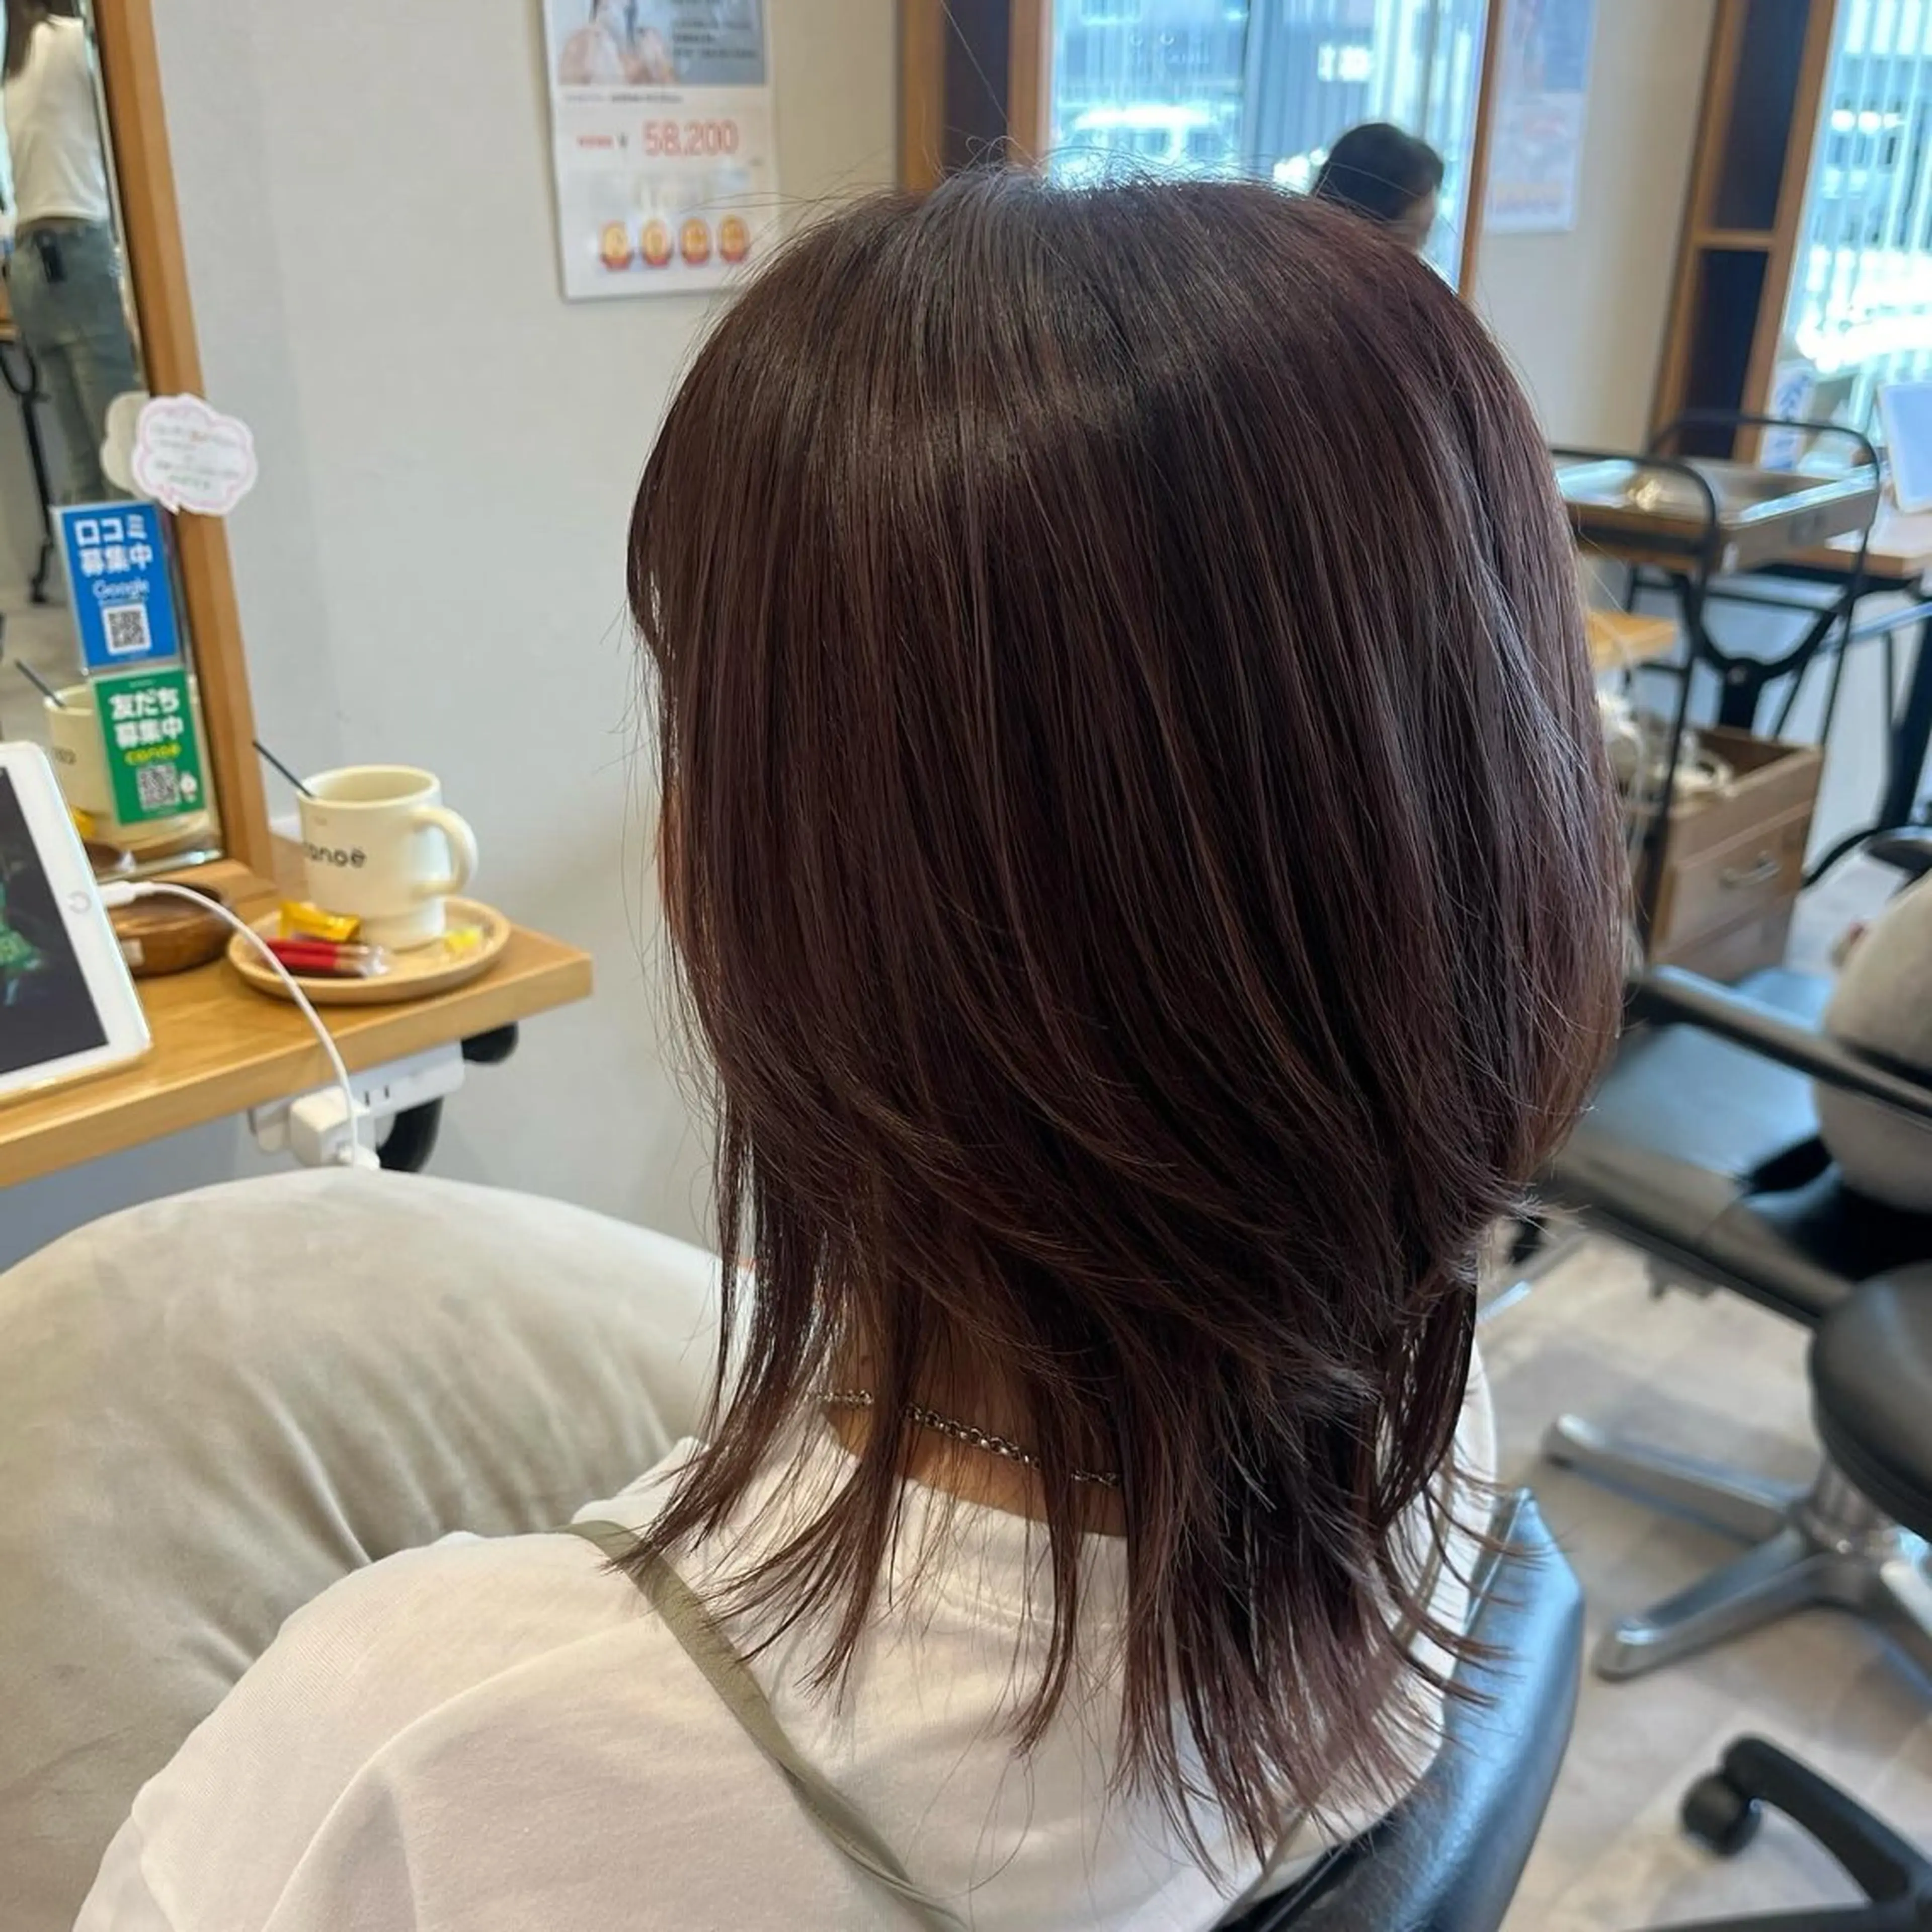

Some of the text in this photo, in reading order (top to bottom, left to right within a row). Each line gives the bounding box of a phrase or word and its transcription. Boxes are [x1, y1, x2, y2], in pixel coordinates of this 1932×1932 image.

[74, 514, 147, 547] 口コミ
[79, 542, 153, 577] 募集中
[108, 687, 180, 720] 友だち
[114, 715, 184, 750] 募集中
